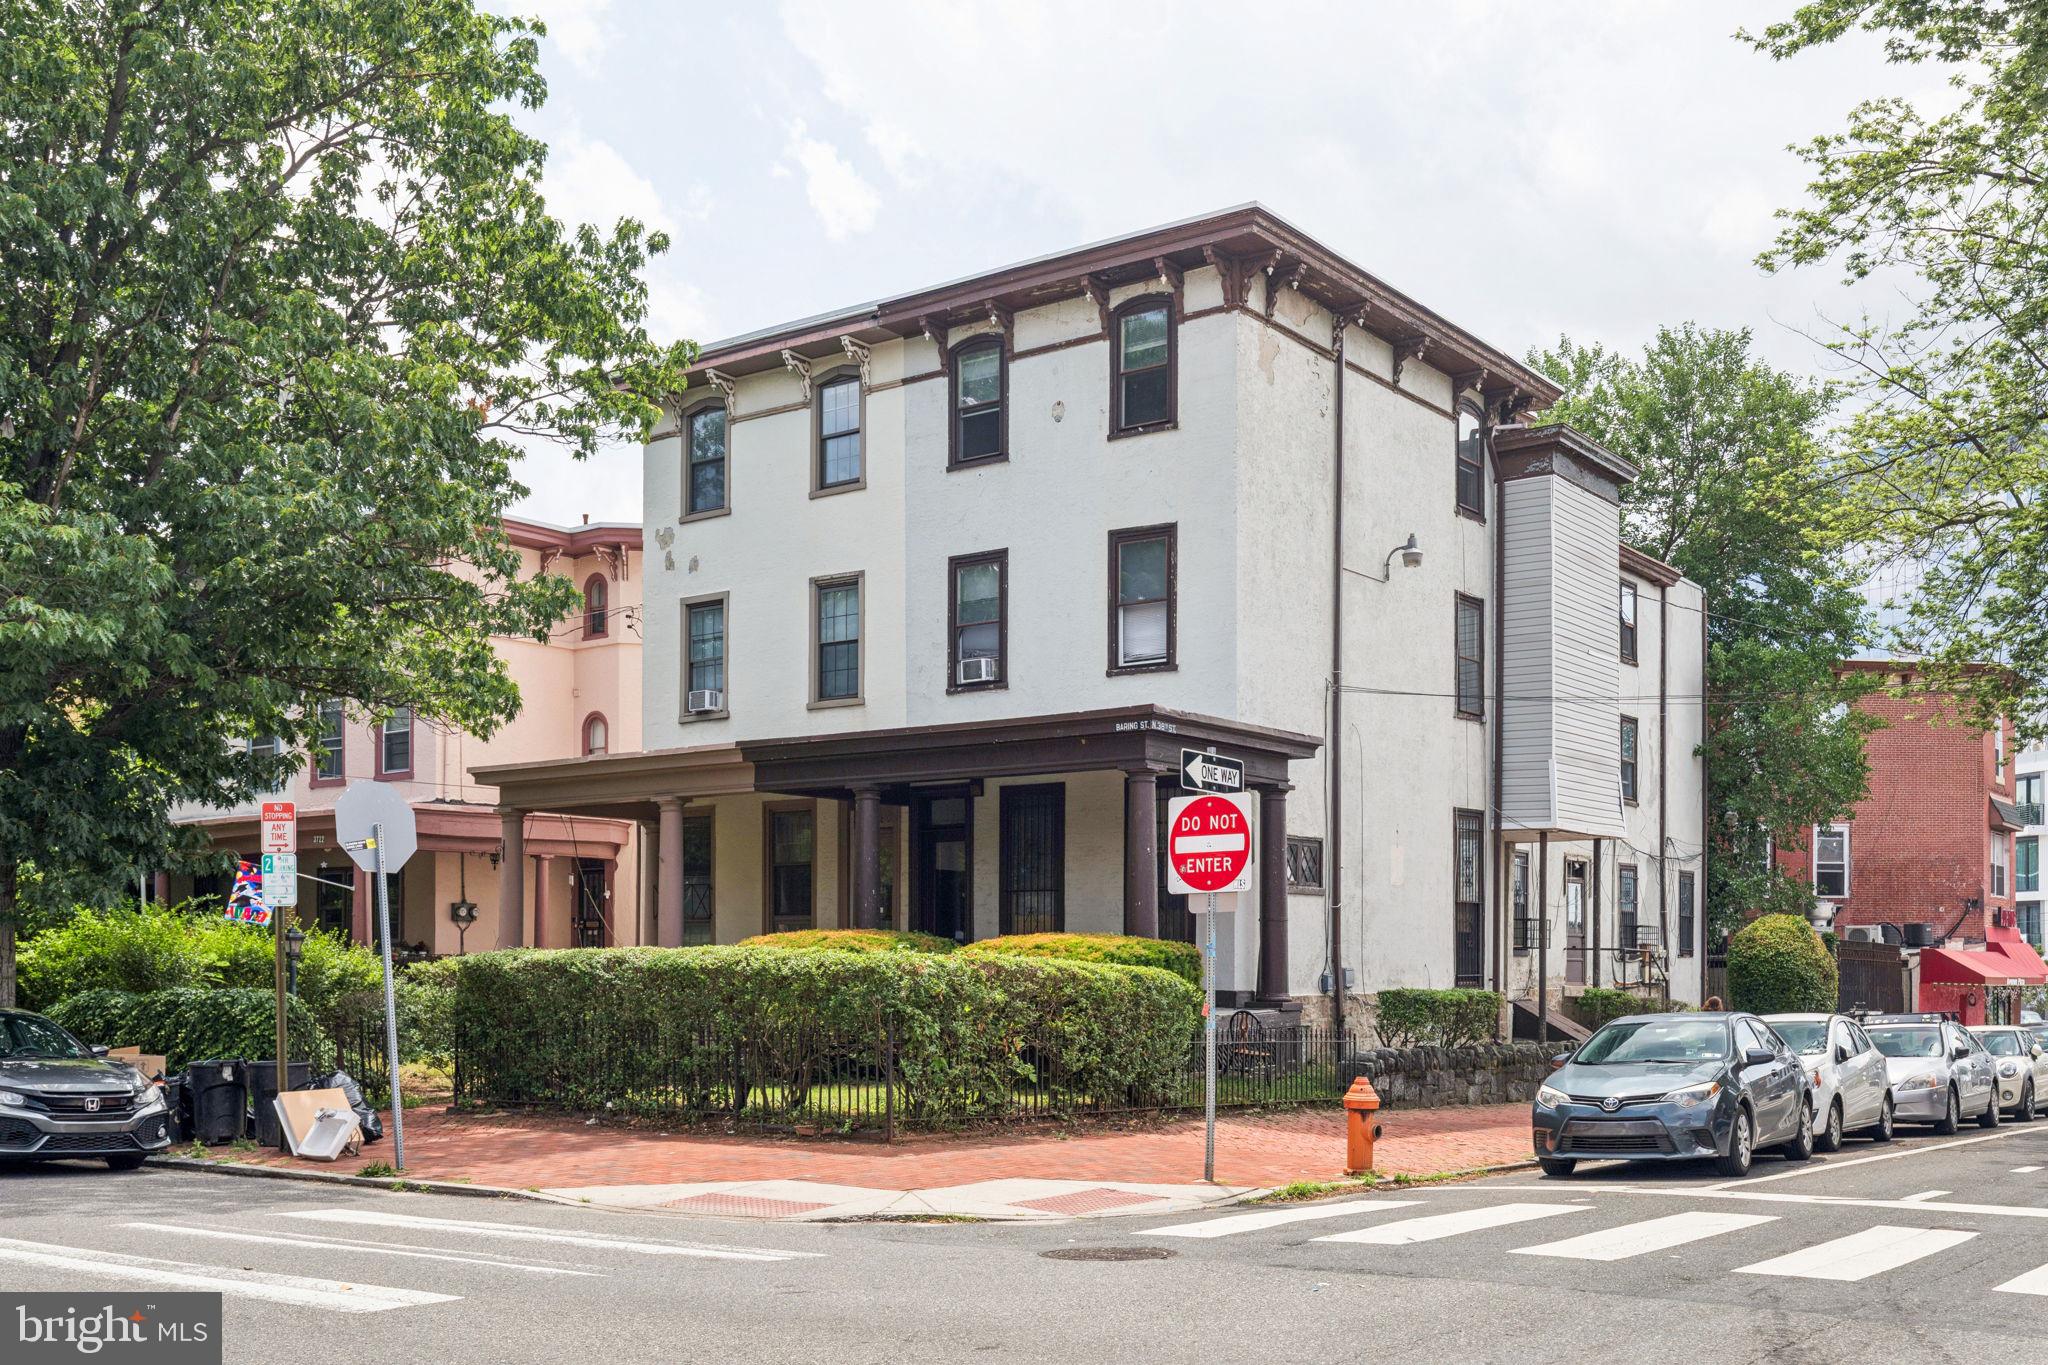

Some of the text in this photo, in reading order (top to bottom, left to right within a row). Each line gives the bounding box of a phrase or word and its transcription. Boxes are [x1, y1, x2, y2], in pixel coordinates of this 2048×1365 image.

[1115, 721, 1138, 731] BARING
[1202, 765, 1238, 785] ONE WAY
[274, 804, 283, 812] NO
[264, 812, 293, 820] STOPPING
[271, 823, 286, 832] ANY
[1181, 814, 1238, 832] DO NOT
[271, 832, 288, 841] TIME
[264, 857, 272, 871] 2
[1187, 857, 1232, 873] ENTER
